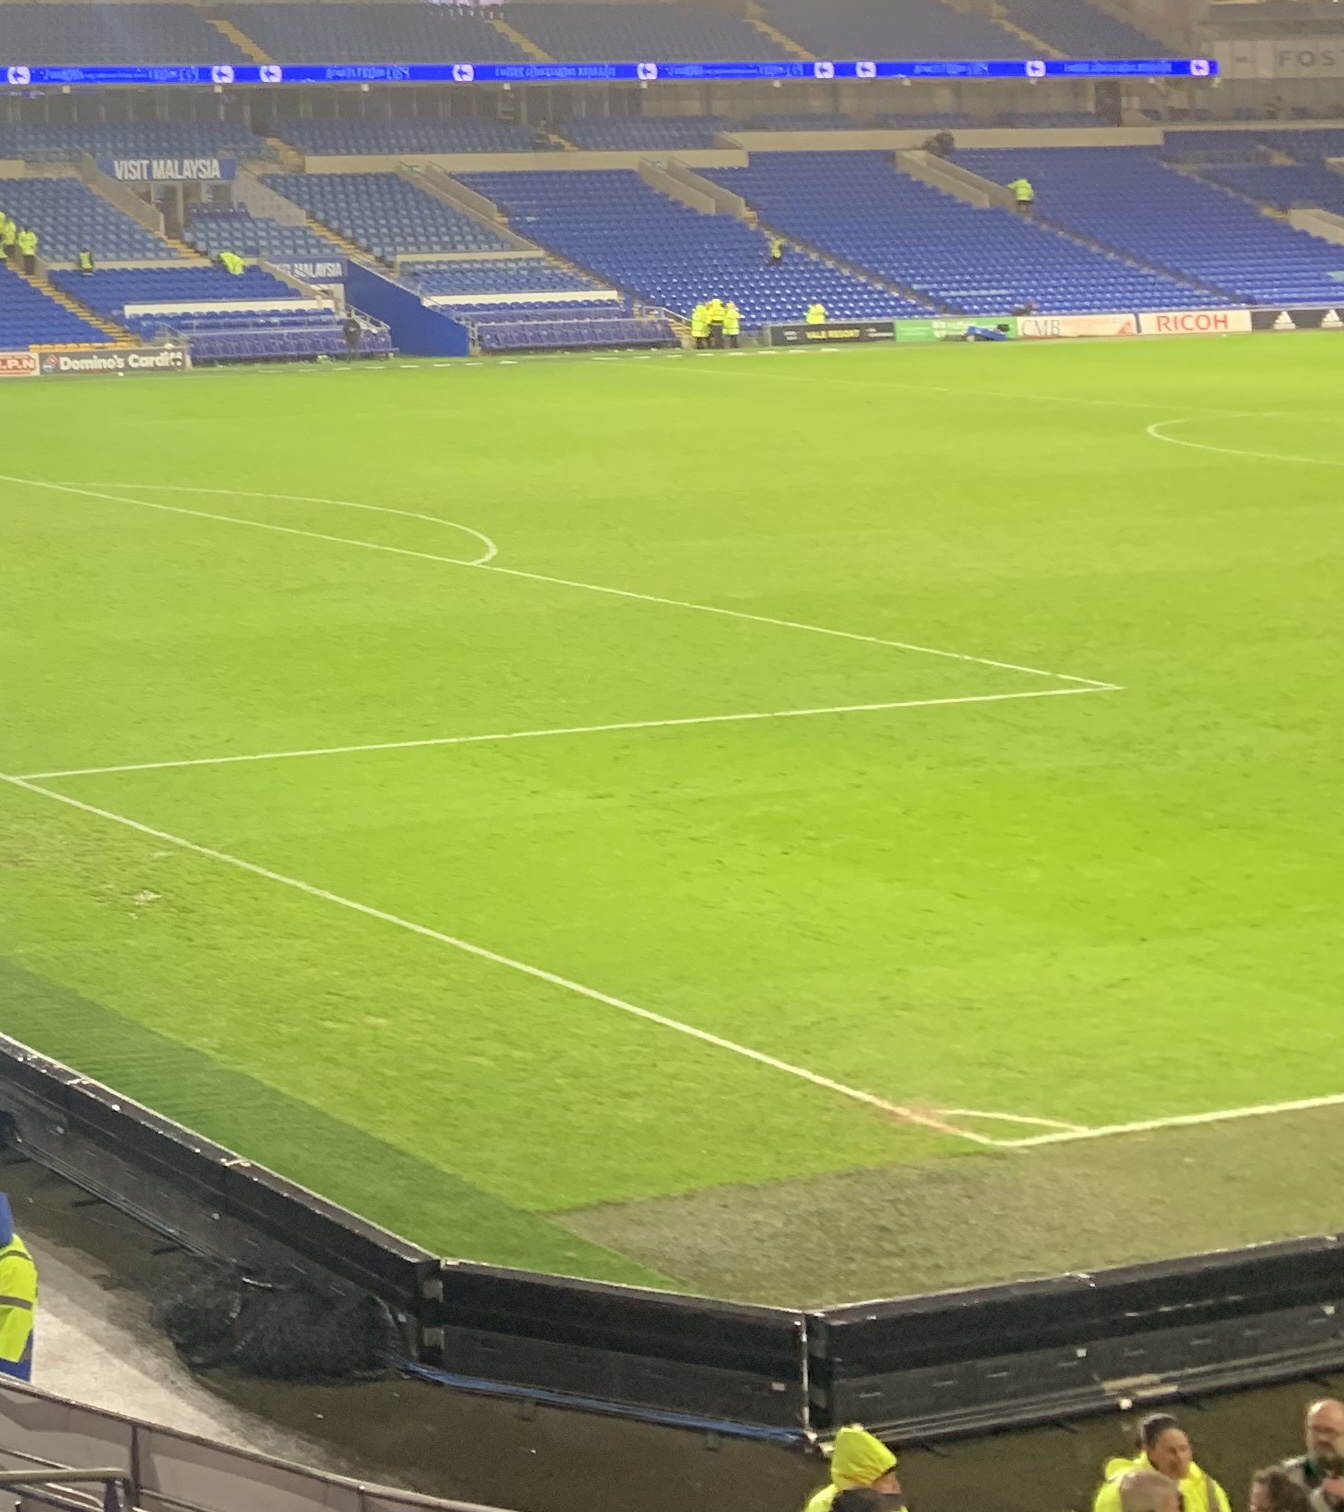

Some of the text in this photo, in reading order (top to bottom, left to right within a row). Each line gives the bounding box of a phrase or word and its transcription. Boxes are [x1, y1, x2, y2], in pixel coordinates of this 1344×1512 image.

[1279, 49, 1344, 68] FOS
[114, 158, 222, 181] VISIT MALAYSIA
[293, 262, 343, 278] MALAYSIA
[1021, 319, 1060, 336] CMB
[1157, 314, 1229, 332] RICOH
[59, 353, 125, 371] Domino's
